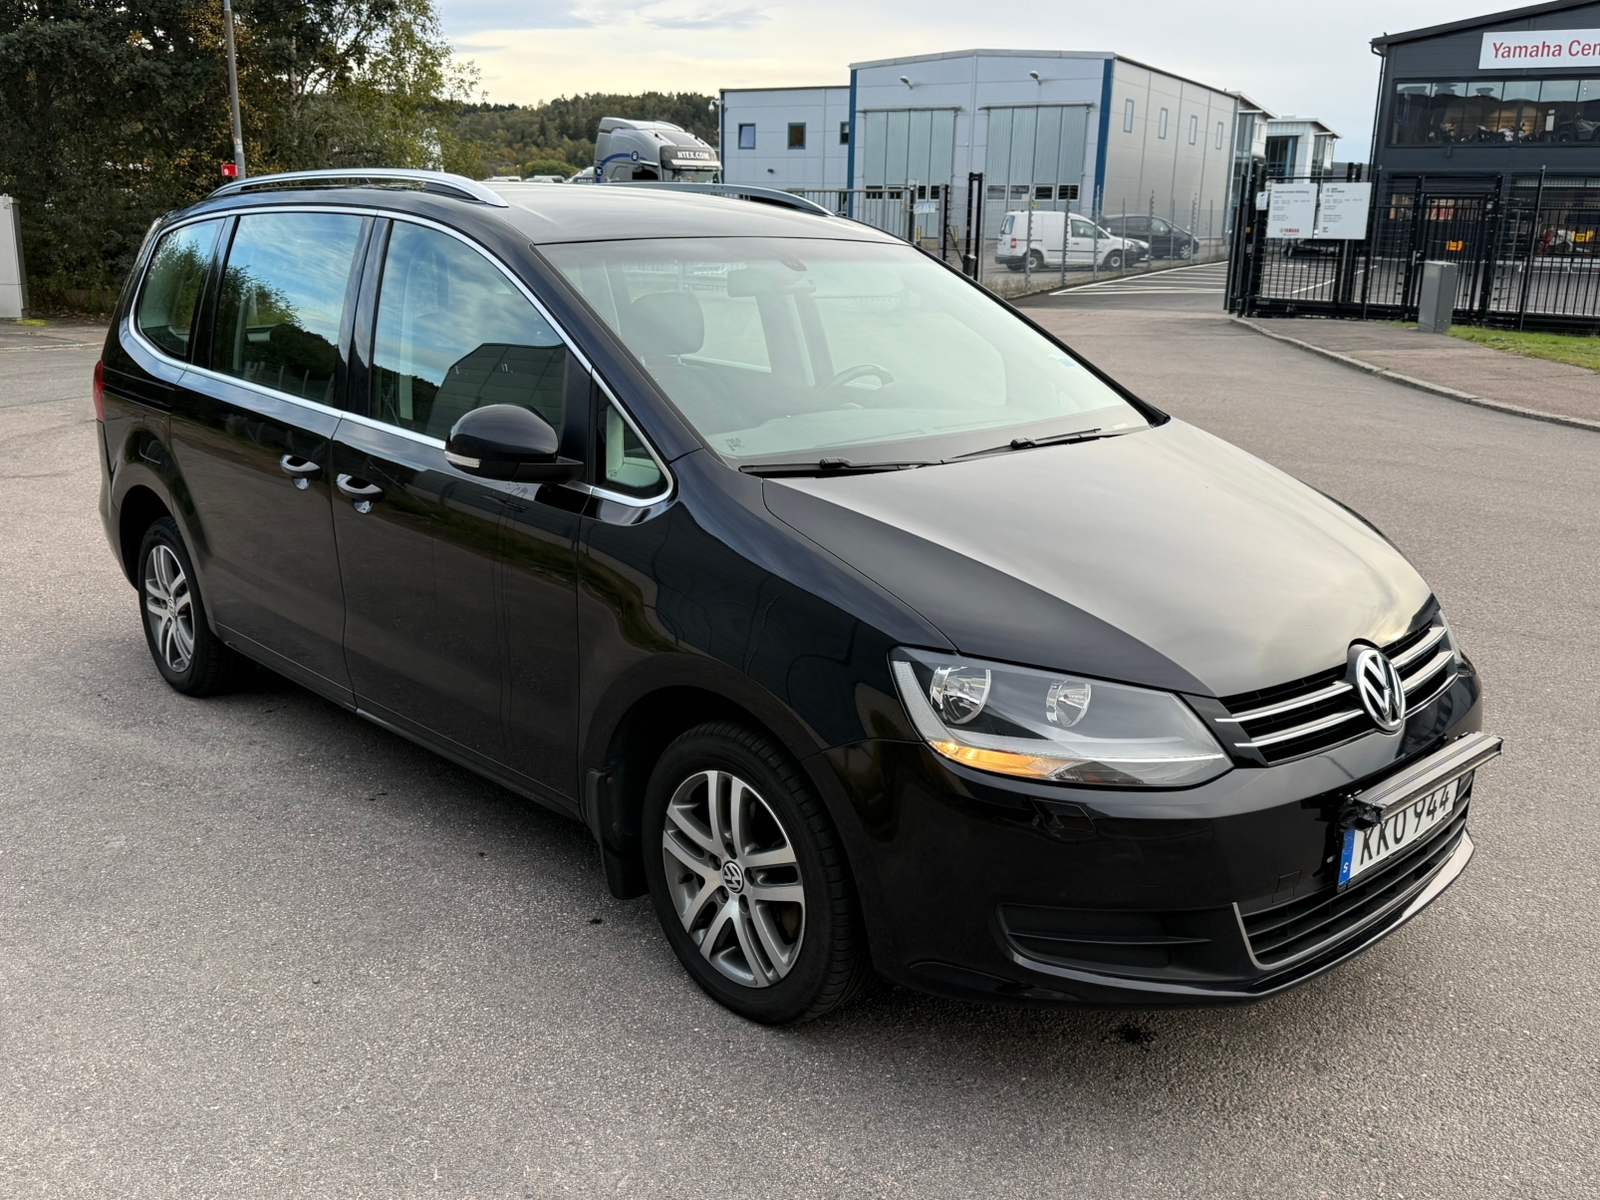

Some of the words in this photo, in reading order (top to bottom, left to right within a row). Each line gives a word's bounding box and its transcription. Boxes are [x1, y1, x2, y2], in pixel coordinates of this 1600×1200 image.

[1492, 40, 1563, 59] Yamaha
[677, 151, 710, 160] NTEX.COM
[1414, 785, 1450, 834] 944
[1342, 861, 1350, 874] S
